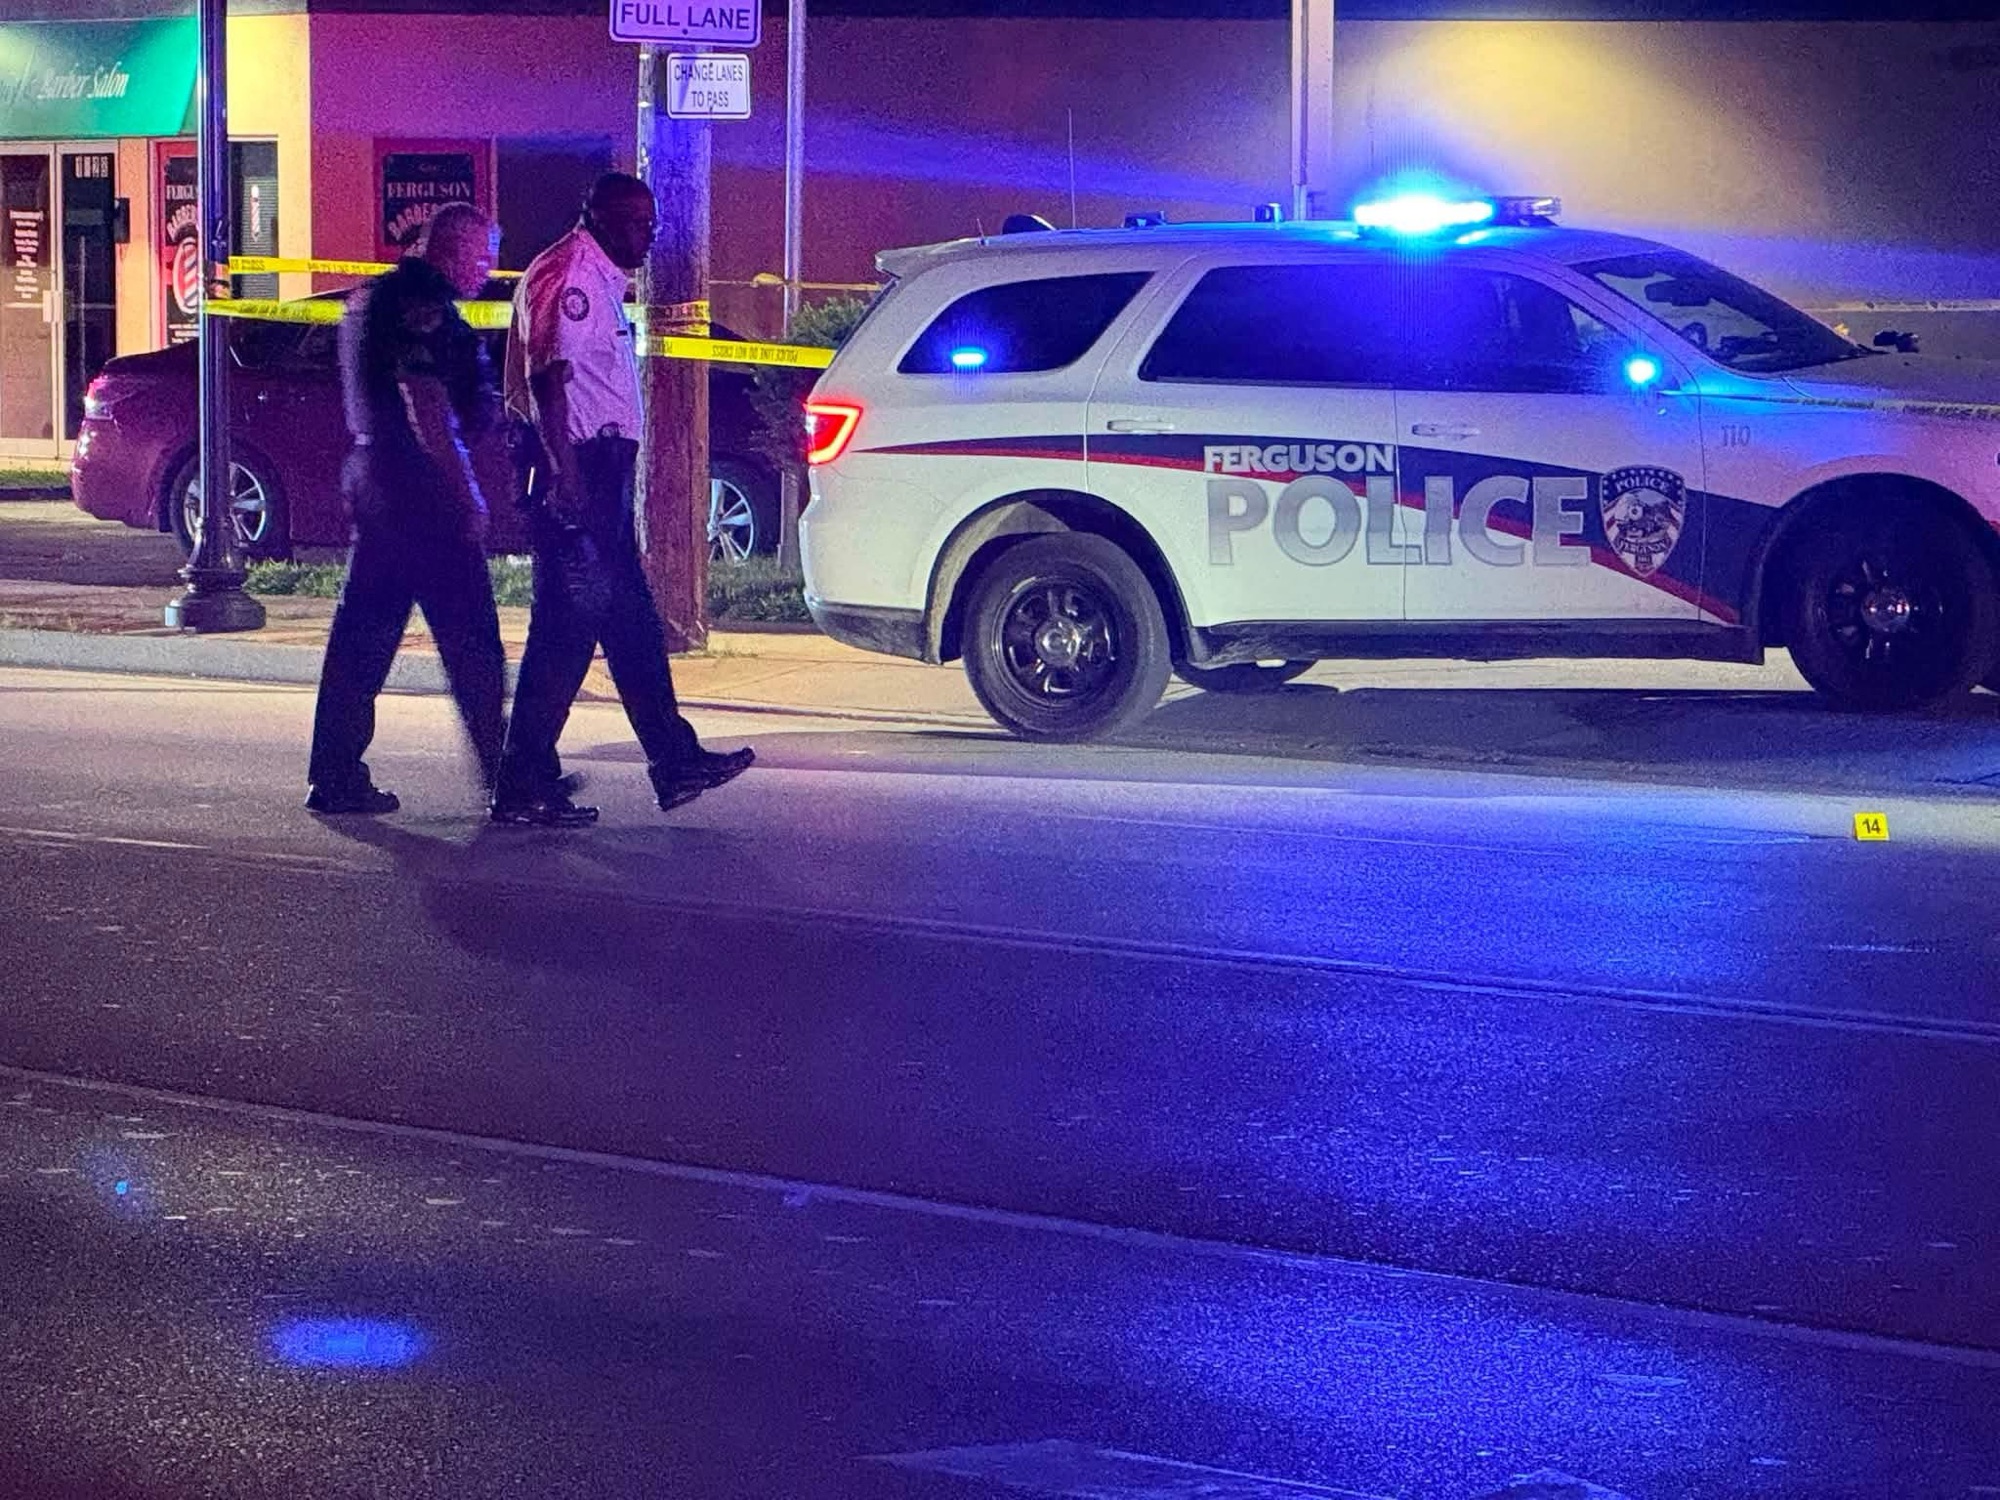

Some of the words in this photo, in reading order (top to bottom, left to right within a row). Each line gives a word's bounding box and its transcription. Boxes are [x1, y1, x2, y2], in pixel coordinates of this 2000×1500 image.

[621, 3, 680, 27] FULL
[687, 6, 751, 30] LANE
[86, 61, 130, 98] Salon
[674, 64, 713, 82] CHANGE
[716, 65, 743, 82] LANES
[691, 91, 705, 107] TO
[707, 91, 729, 107] PASS
[387, 181, 471, 198] FERGUSON
[1204, 444, 1394, 473] FERGUSON
[1616, 476, 1670, 493] POLICE
[1205, 475, 1592, 567] POLICE
[1862, 818, 1881, 834] 14
